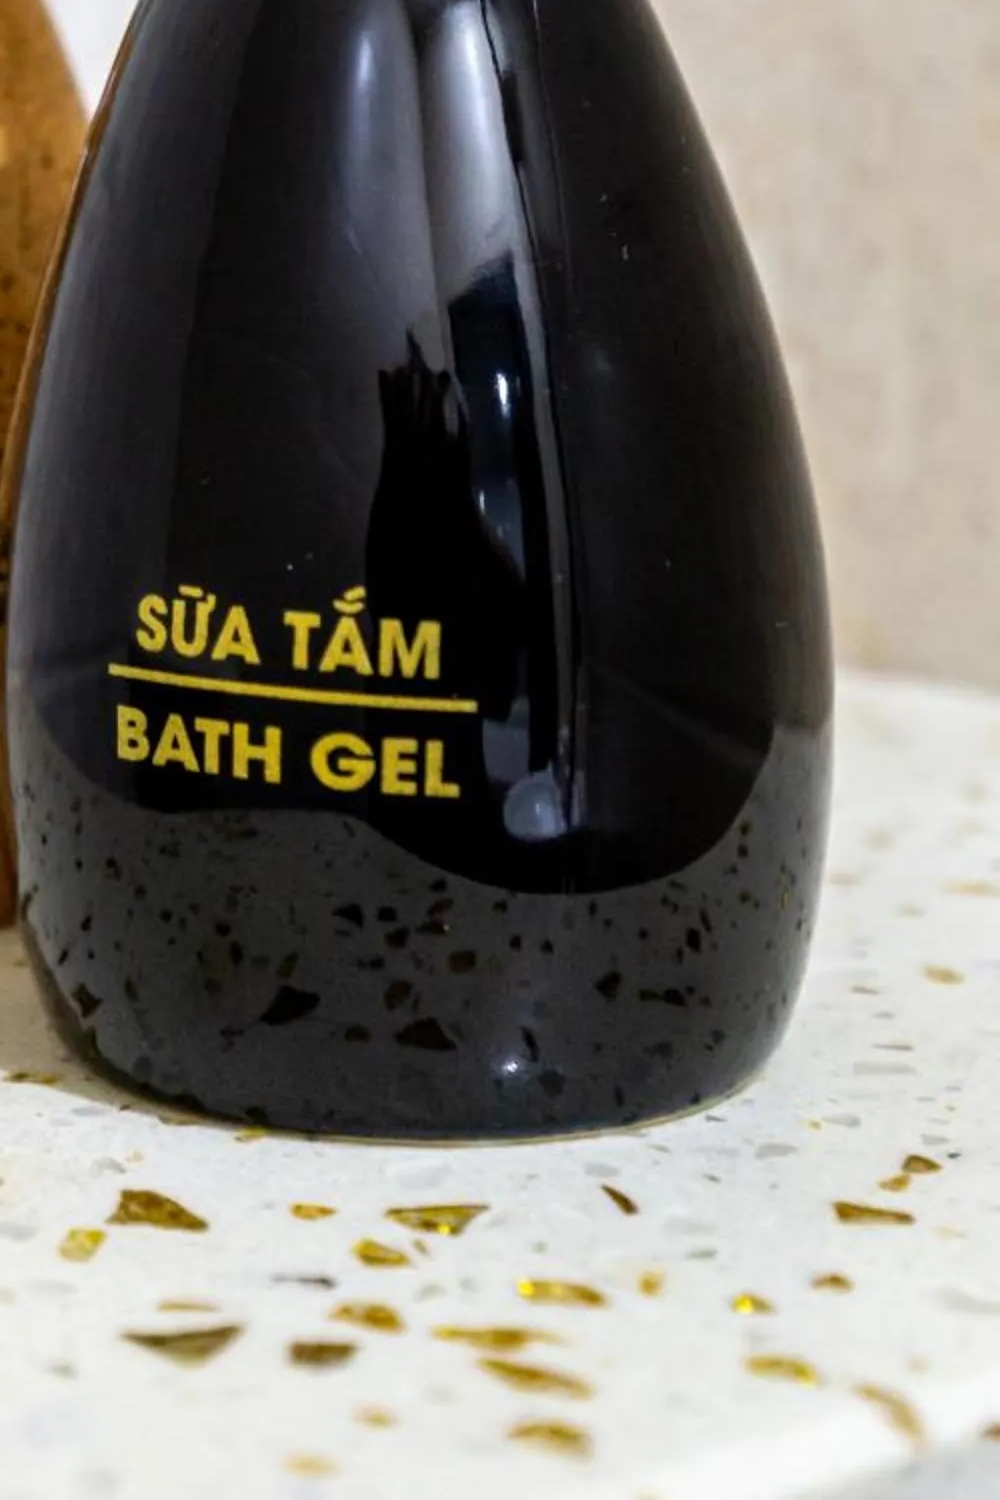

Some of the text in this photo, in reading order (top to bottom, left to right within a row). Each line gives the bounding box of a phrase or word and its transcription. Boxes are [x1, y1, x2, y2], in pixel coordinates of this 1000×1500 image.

[283, 586, 442, 680] TẮM
[116, 703, 461, 799] BATH GEL
